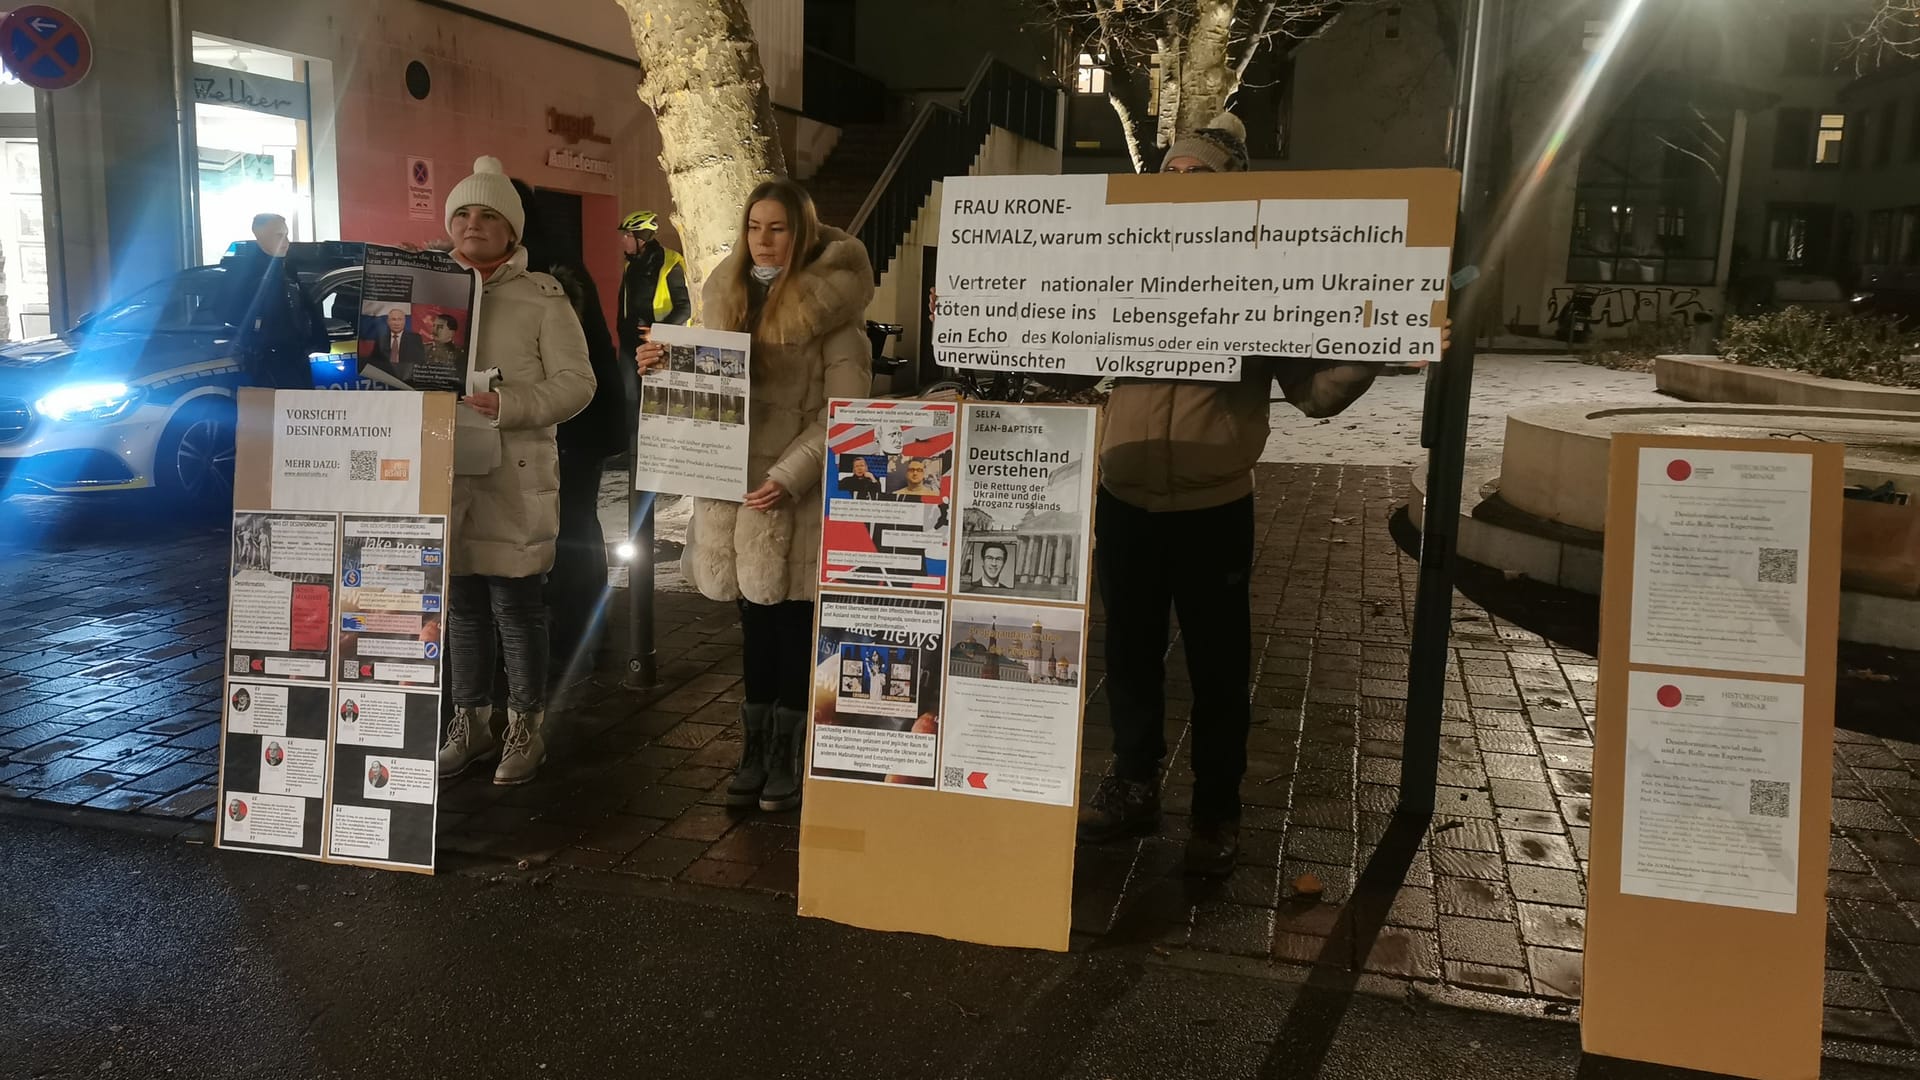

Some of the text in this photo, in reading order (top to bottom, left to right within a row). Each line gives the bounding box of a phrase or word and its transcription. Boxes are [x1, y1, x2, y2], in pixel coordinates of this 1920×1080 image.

[194, 78, 292, 110] Welker
[954, 199, 1071, 214] FRAU KRONE-
[952, 225, 1403, 247] SCHMALZ, warum schickt russland hauptsächlich
[949, 274, 1445, 294] Vertreter nationaler Minderheiten, um Ukrainer zu
[936, 301, 1428, 327] töten und diese ins Lebensgefahr zu bringen? Ist es
[938, 328, 1434, 355] ein Echo des Kolonialismus oder ein versteckter Genozid an
[938, 350, 1237, 375] unerwünschten Volksgruppen?
[287, 409, 346, 420] VORSICHT!
[975, 410, 1000, 418] SELFA
[287, 425, 391, 437] DESINFORMATION!
[975, 424, 1043, 434] JEAN-BAPTISTE
[970, 447, 1069, 463] Deutschland
[285, 459, 340, 469] MEHR DAZU:
[969, 464, 1048, 478] verstehen
[991, 482, 1027, 493] Rettung
[1029, 484, 1044, 492] der
[974, 491, 1046, 501] Ukraine und die
[972, 500, 1060, 511] Arroganz russlands
